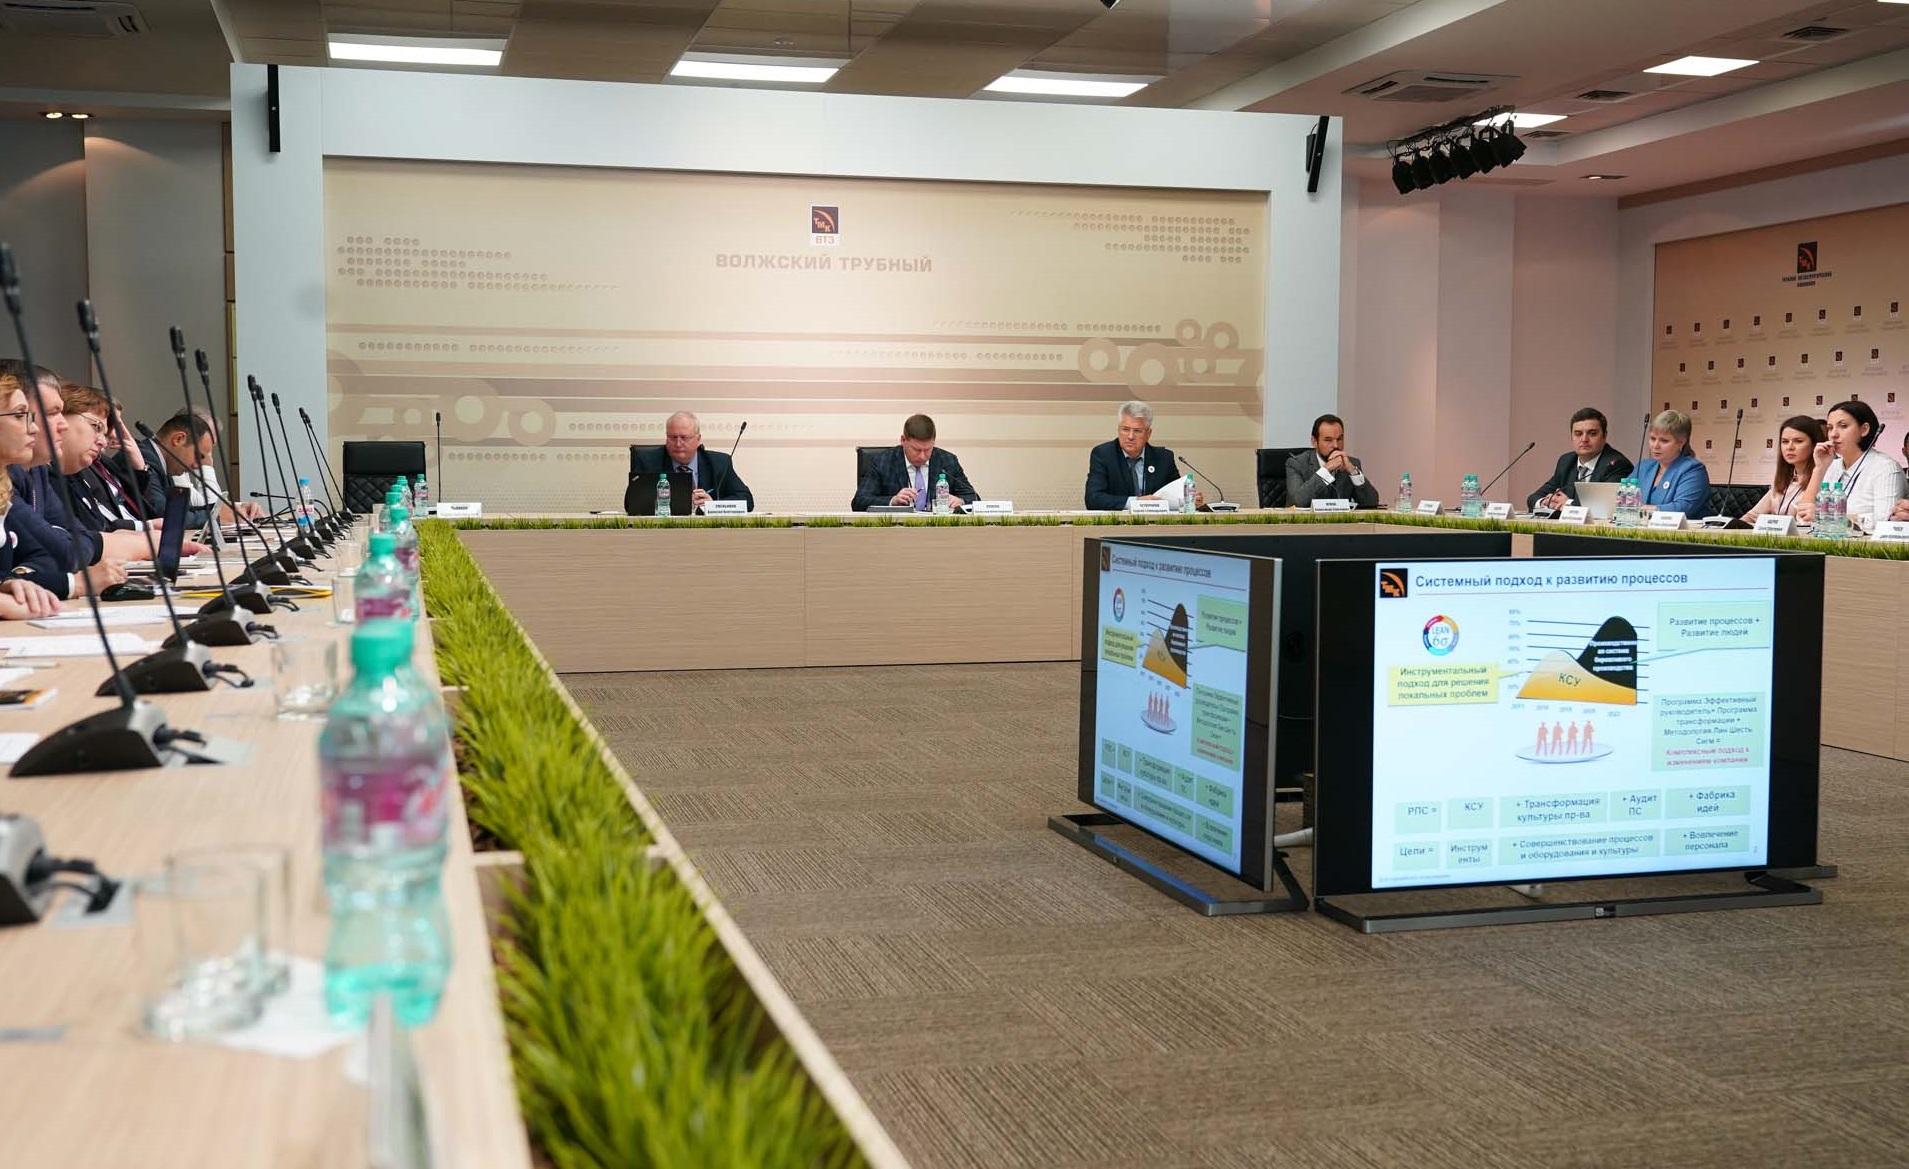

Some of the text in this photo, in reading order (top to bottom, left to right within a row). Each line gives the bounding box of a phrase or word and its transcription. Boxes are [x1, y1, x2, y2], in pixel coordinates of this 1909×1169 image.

[715, 253, 932, 272] ВОЛЖСКИЙ ТРУБНЫЙ
[1415, 573, 1688, 588] Системный подход к развитию процессов
[1669, 617, 1707, 626] Развитие
[1709, 616, 1753, 628] процессов
[1681, 628, 1749, 638] Развитие людей
[1400, 664, 1487, 677] Инструментальный
[1398, 678, 1489, 689] подход для решения
[1559, 673, 1581, 687] КСУ
[1398, 689, 1488, 700] локальных проблем
[1629, 794, 1657, 805] Аудит
[1696, 790, 1735, 802] Фабрика
[1464, 801, 1484, 811] КСУ
[1524, 796, 1601, 810] Трансформация
[1696, 803, 1719, 813] идей
[1407, 806, 1428, 816] РПС
[1628, 807, 1642, 816] ПС
[1517, 812, 1563, 823] культуры
[1609, 833, 1654, 845] процессов
[1689, 830, 1739, 840] Вовлечение
[1400, 847, 1425, 857] Цели
[1450, 844, 1488, 853] Инструм
[1685, 841, 1729, 852] персонала
